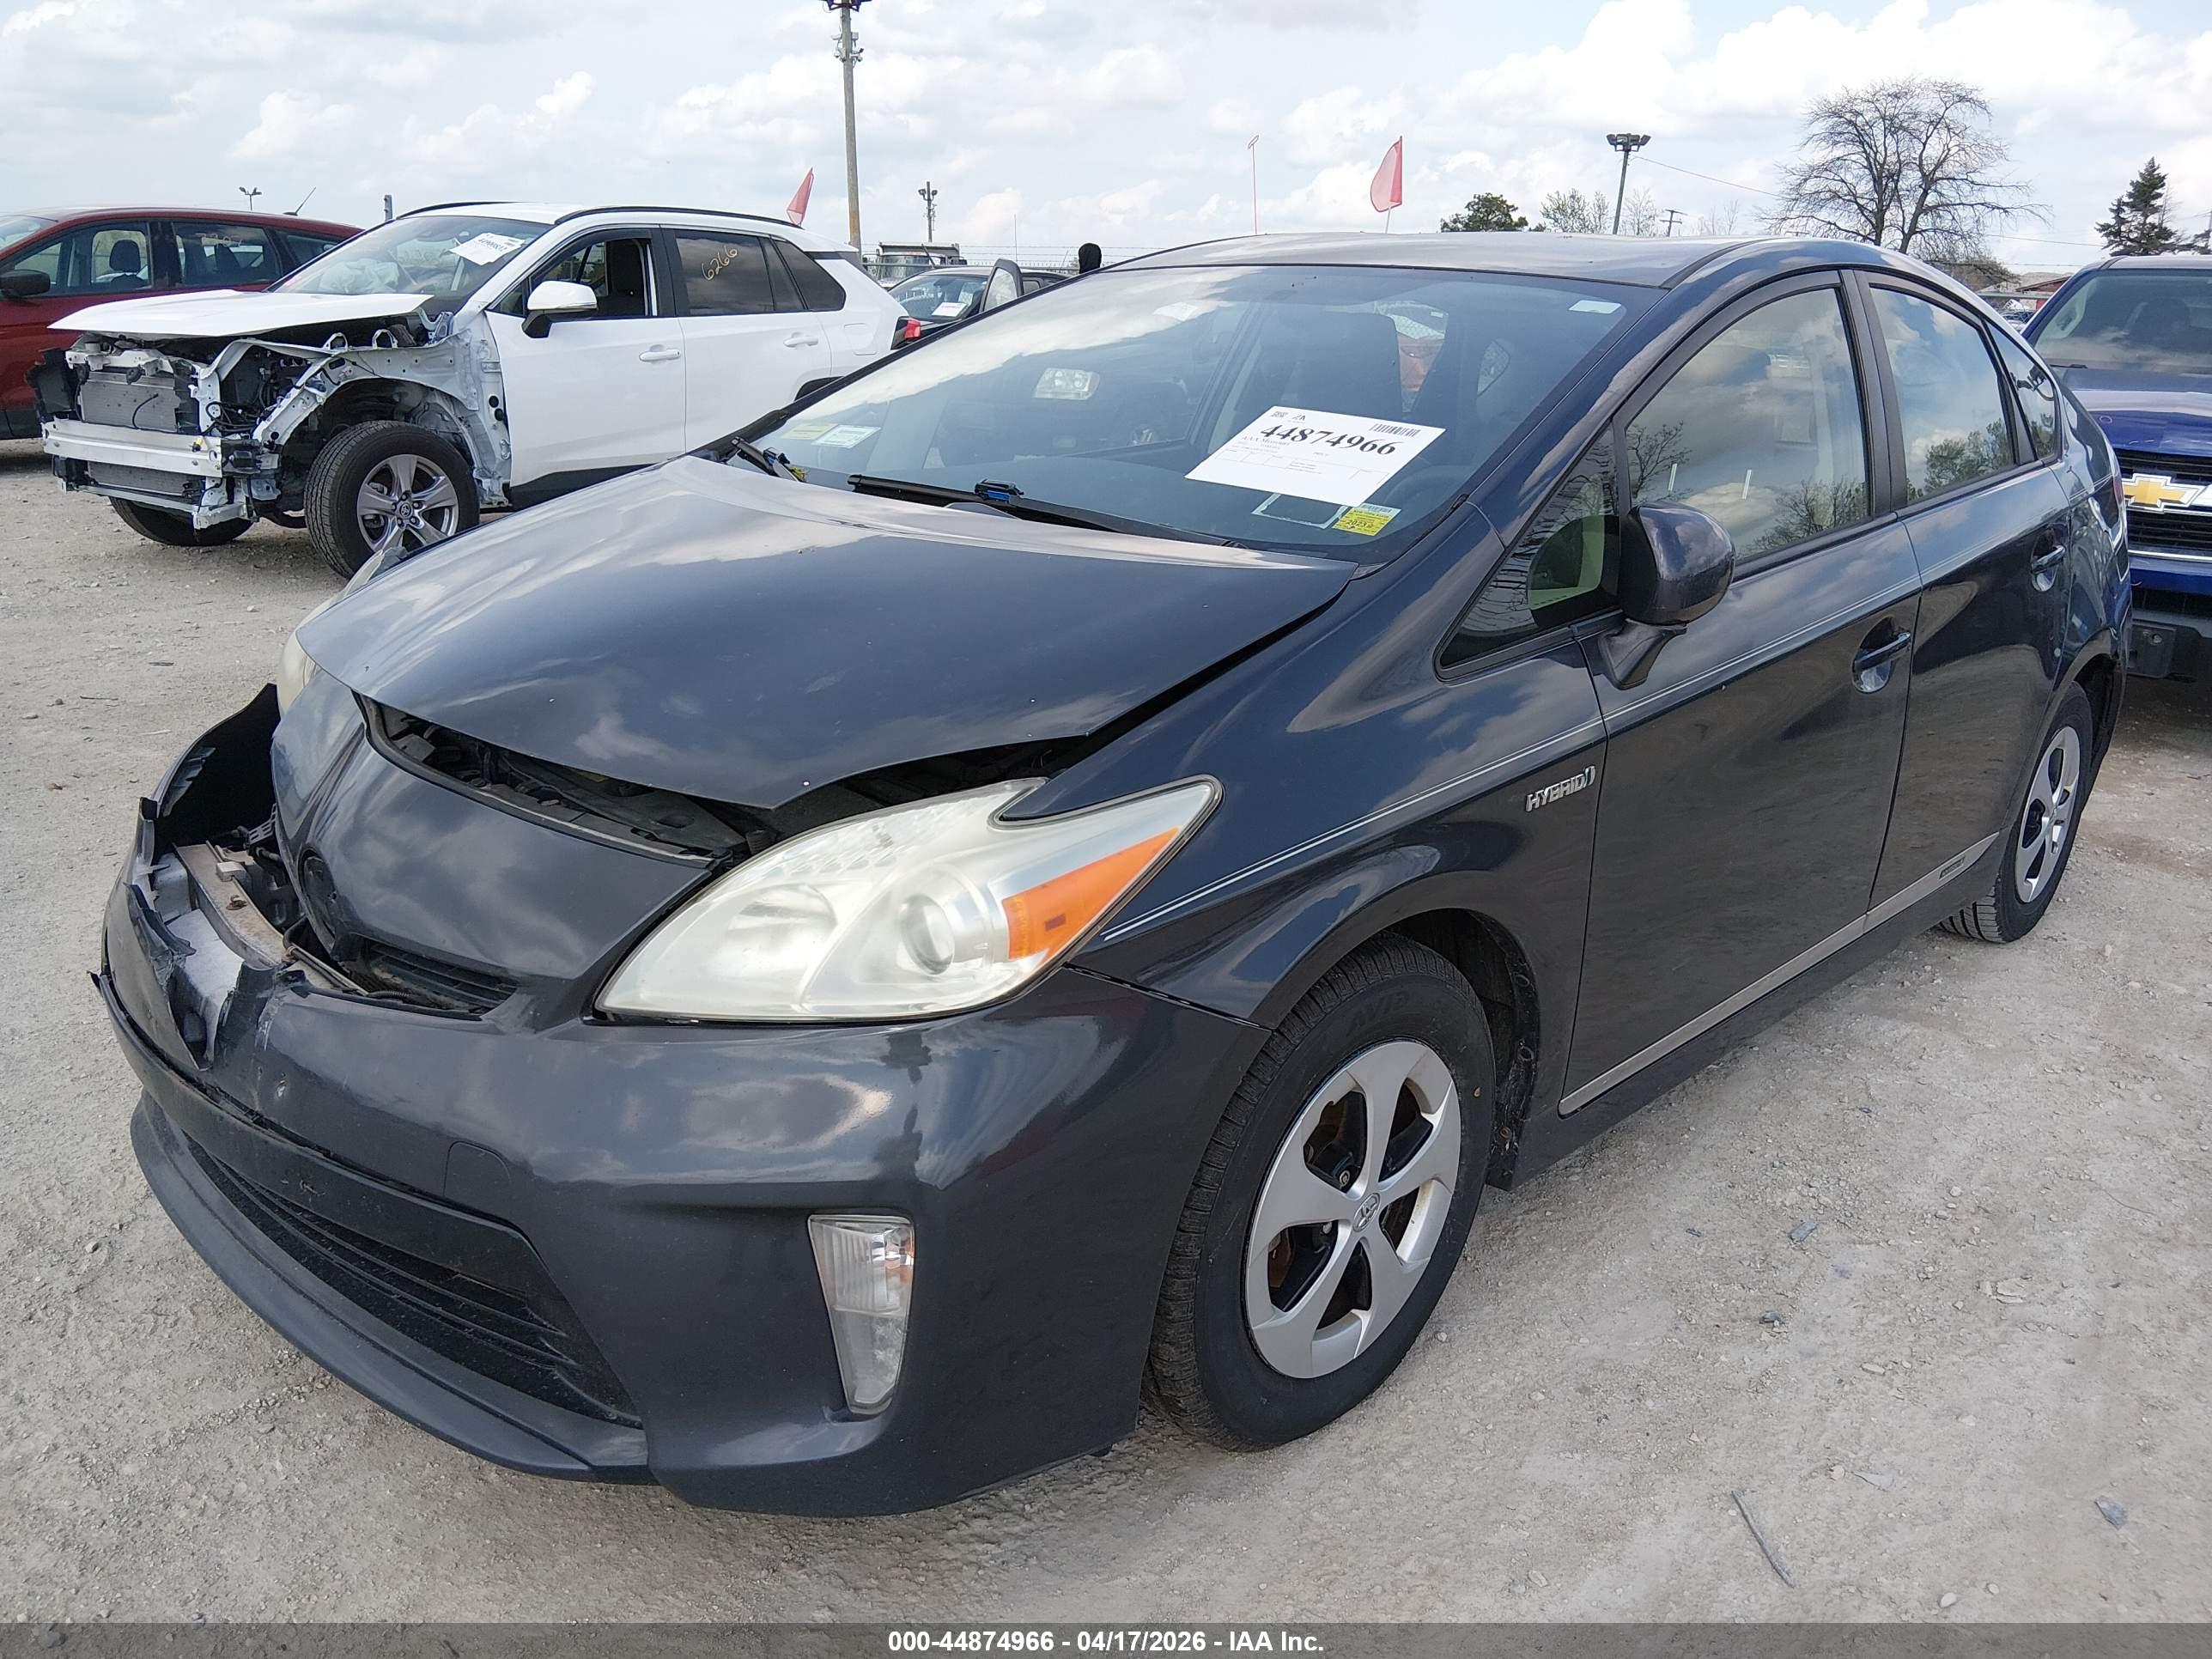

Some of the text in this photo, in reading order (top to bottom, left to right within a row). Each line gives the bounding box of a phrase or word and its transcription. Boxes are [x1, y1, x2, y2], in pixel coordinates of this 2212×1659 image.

[701, 245, 738, 281] 6266
[1260, 424, 1404, 455] 44874966
[1526, 771, 1588, 812] HYBRID
